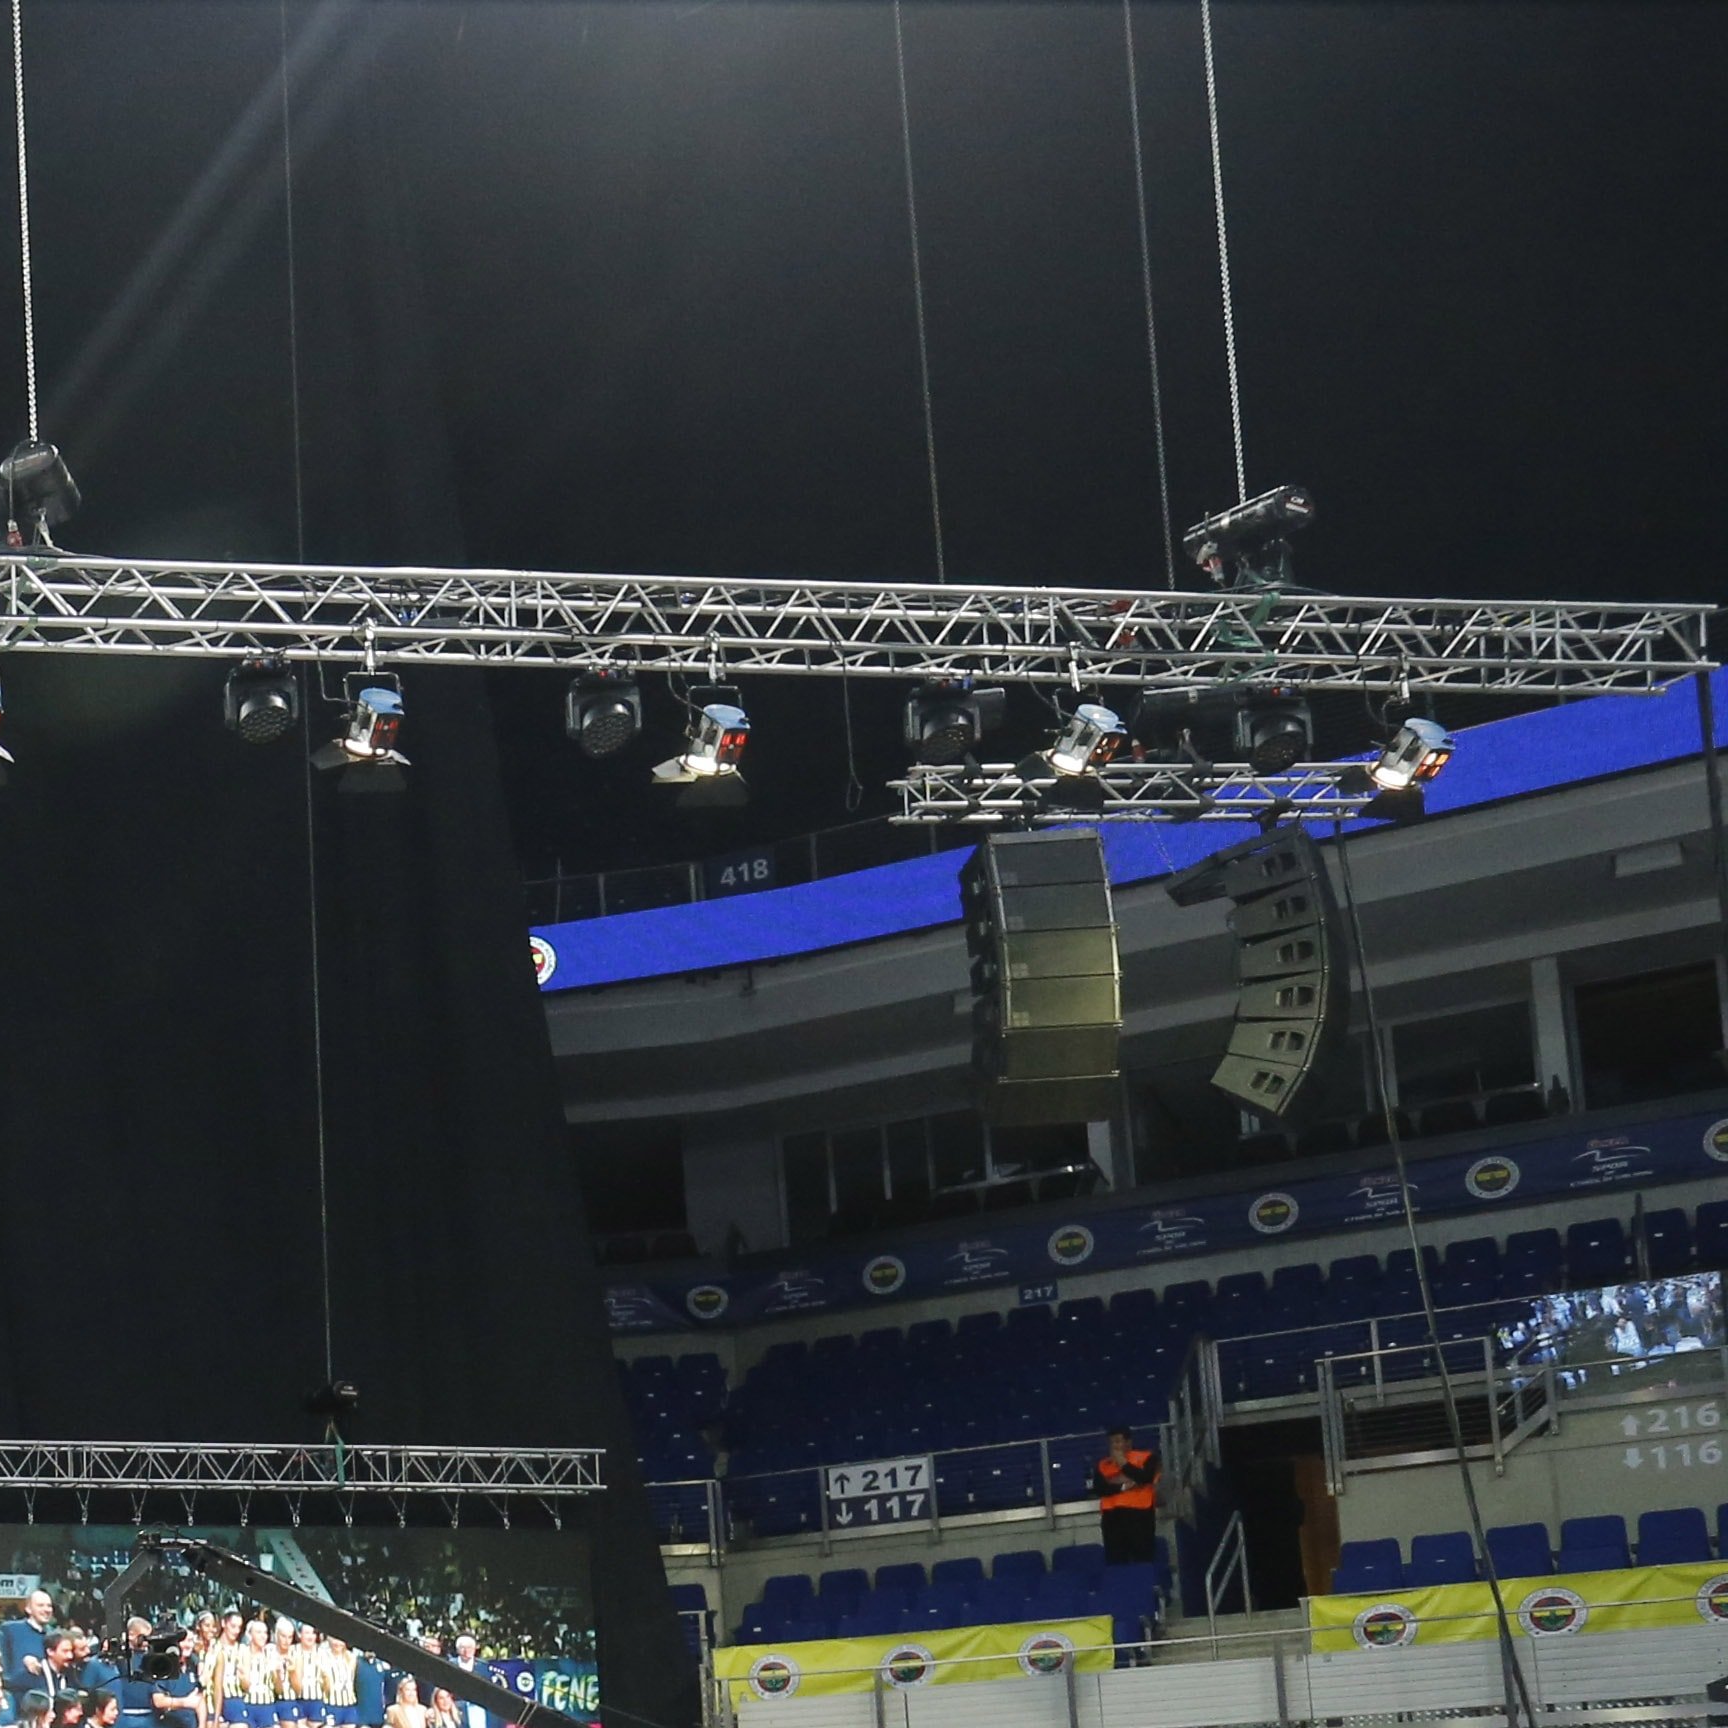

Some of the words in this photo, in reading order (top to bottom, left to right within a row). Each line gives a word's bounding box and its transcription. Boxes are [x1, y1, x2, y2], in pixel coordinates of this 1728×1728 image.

[719, 858, 769, 886] 418
[1022, 1285, 1054, 1300] 217
[1647, 1401, 1721, 1433] 216
[1650, 1440, 1723, 1470] 116
[861, 1464, 923, 1492] 217
[863, 1492, 925, 1521] 117
